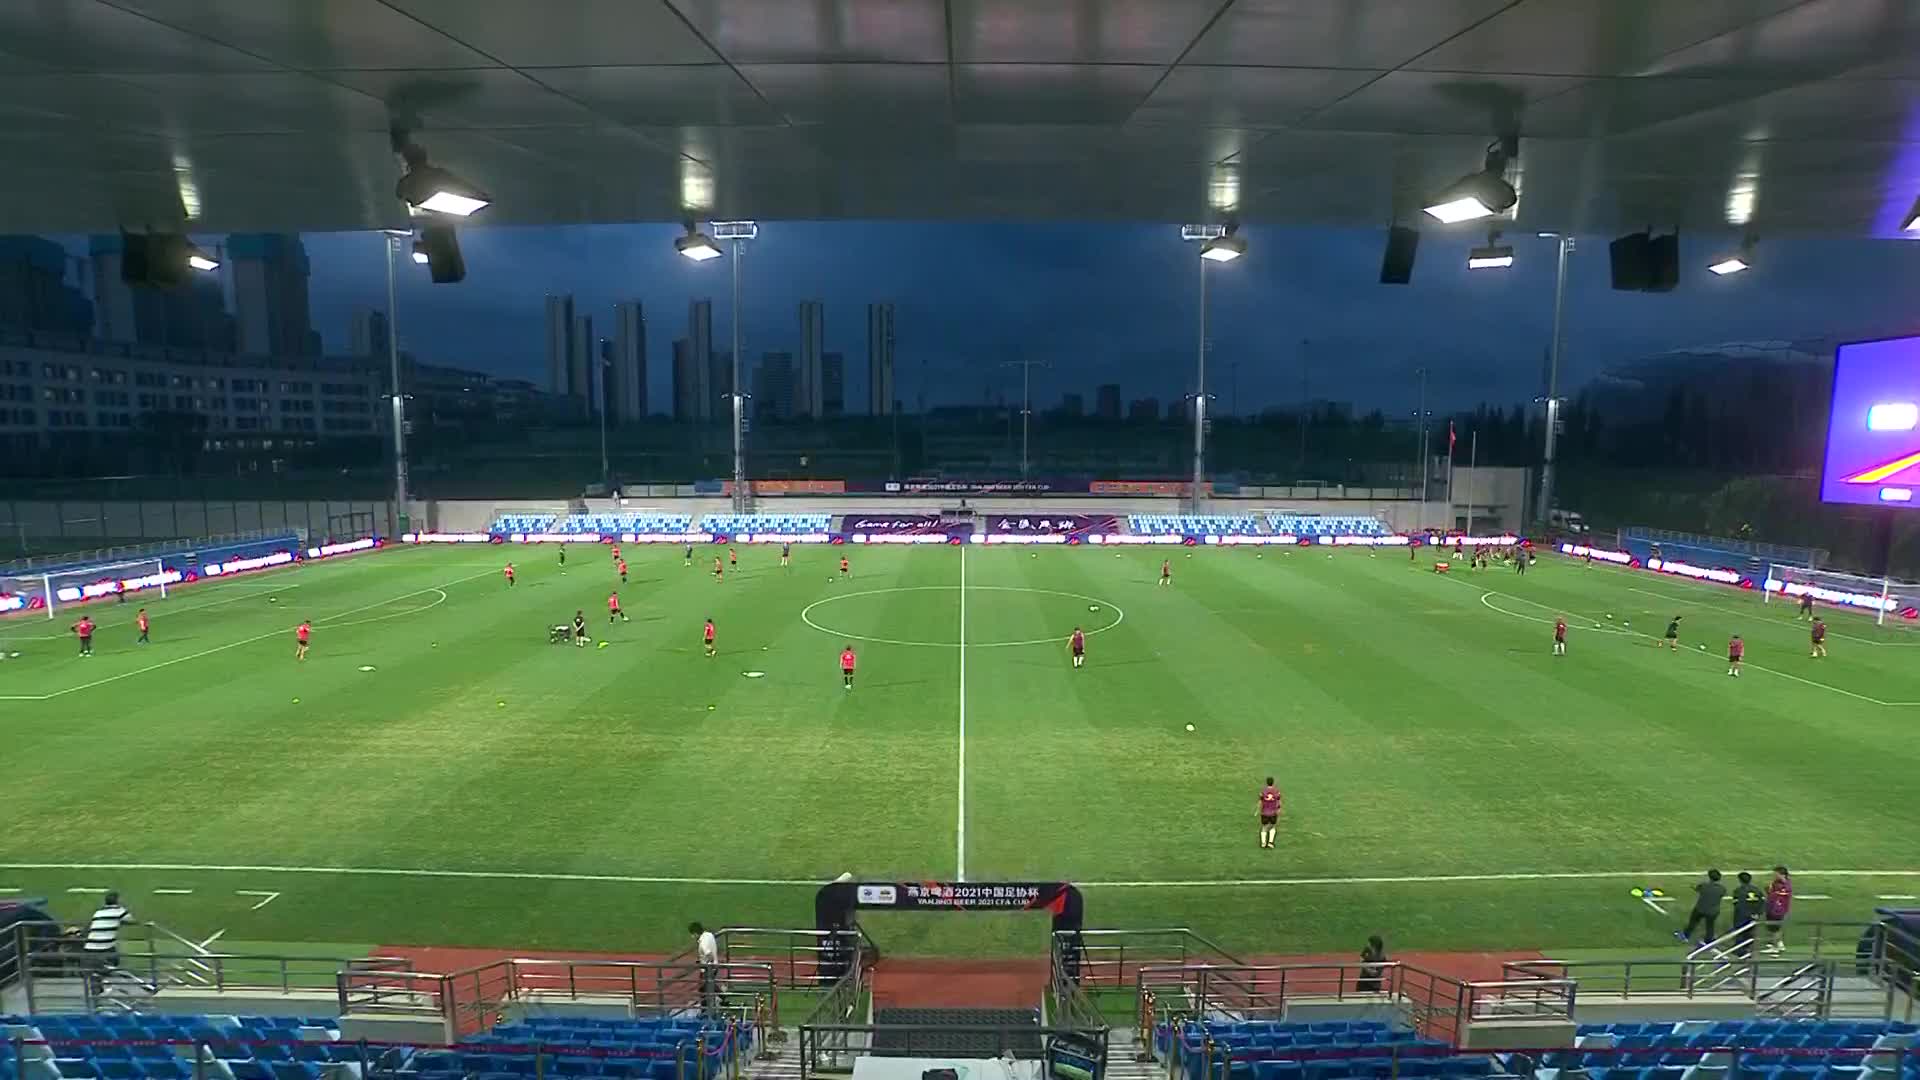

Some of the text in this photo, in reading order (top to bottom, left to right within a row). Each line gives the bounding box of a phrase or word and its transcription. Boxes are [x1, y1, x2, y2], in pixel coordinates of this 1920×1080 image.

[891, 520, 914, 529] for
[907, 886, 1040, 898] 燕京啤酒2021中国足协杯
